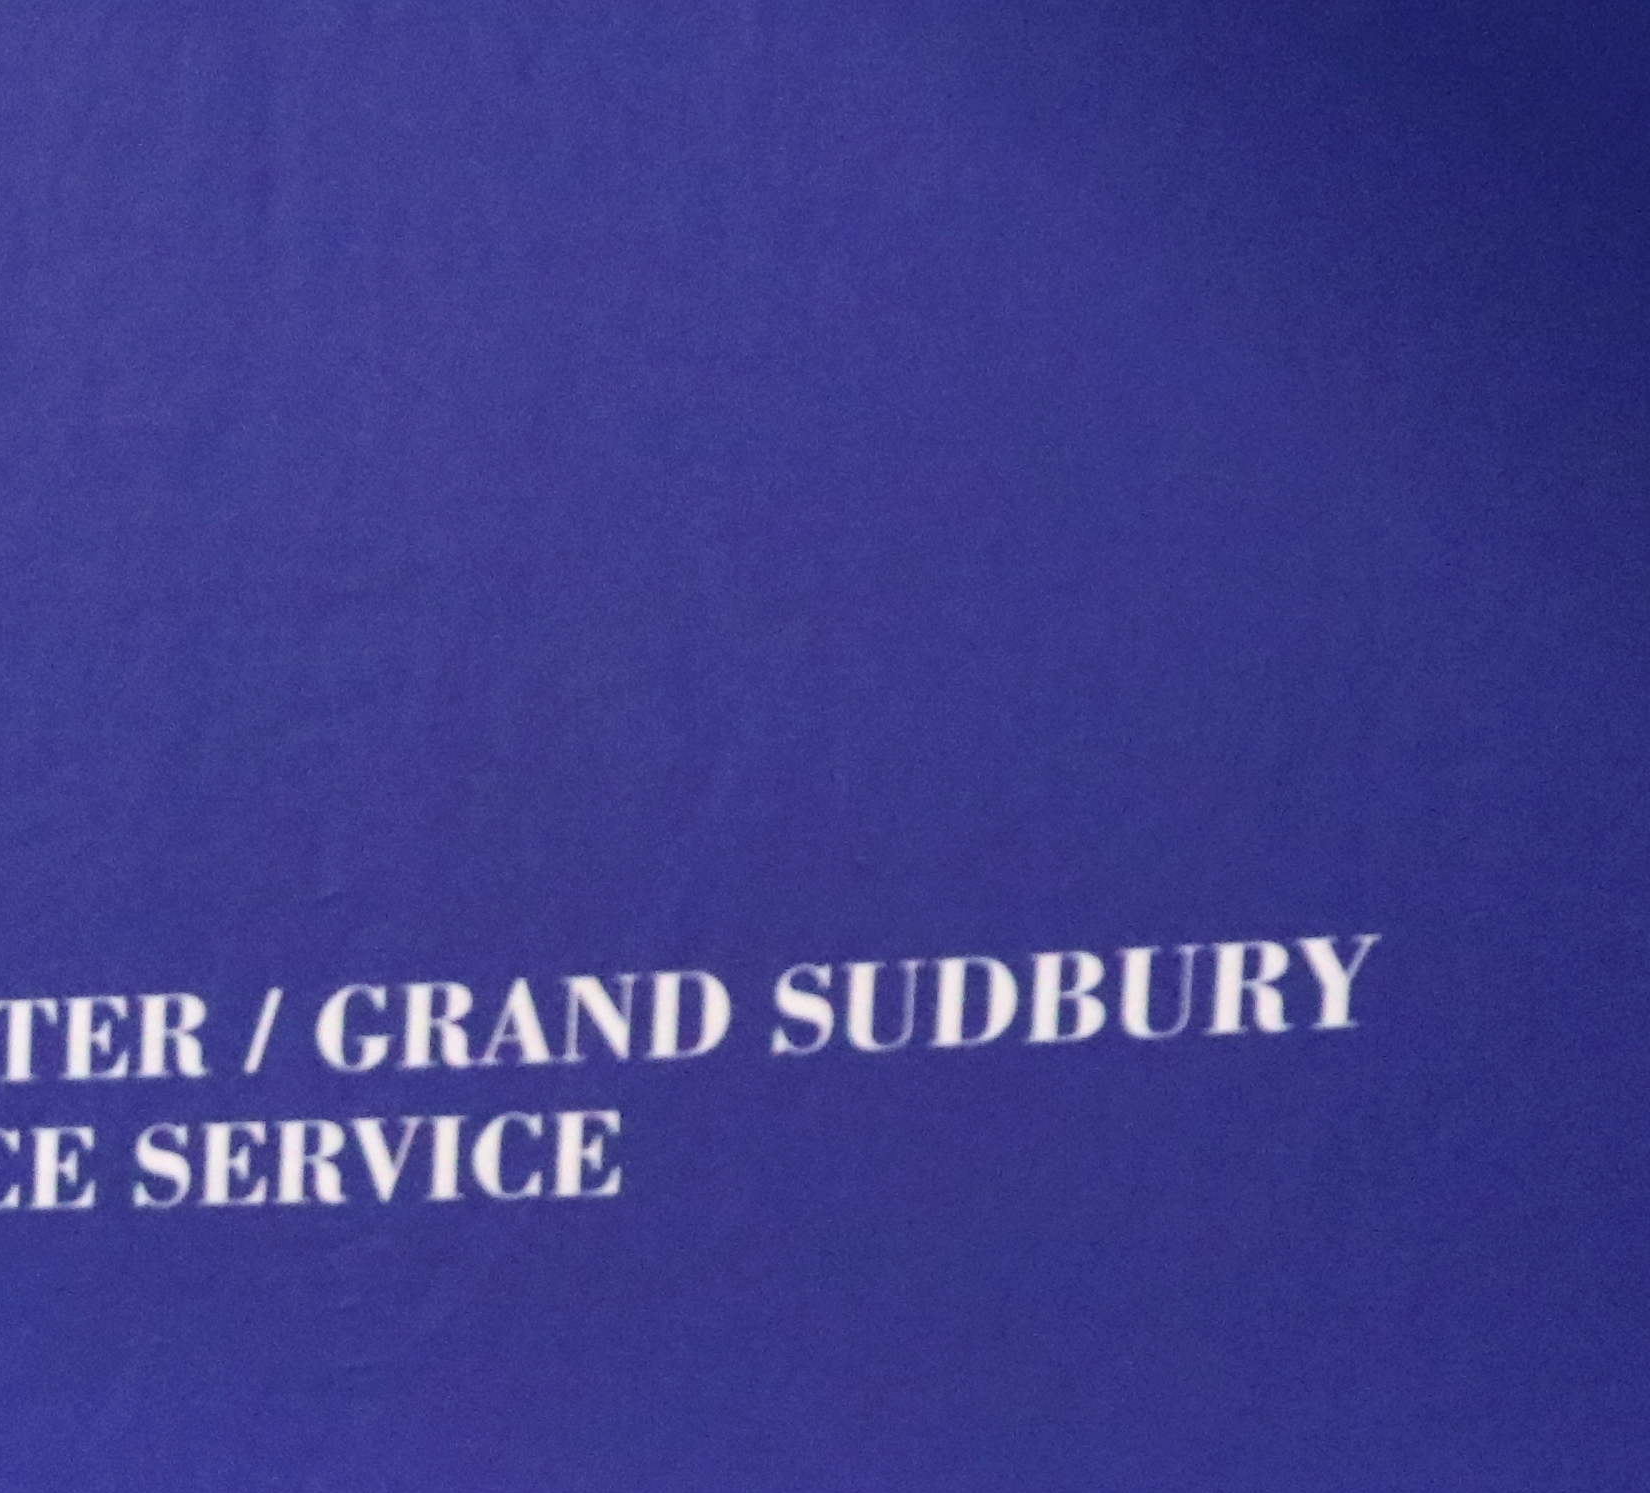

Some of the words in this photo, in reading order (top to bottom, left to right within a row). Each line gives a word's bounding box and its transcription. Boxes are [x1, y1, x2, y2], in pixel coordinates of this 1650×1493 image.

[244, 987, 283, 1073] /
[316, 972, 731, 1072] GRAND
[772, 935, 1379, 1053] SUDBURY
[134, 1110, 621, 1207] SERVICE
